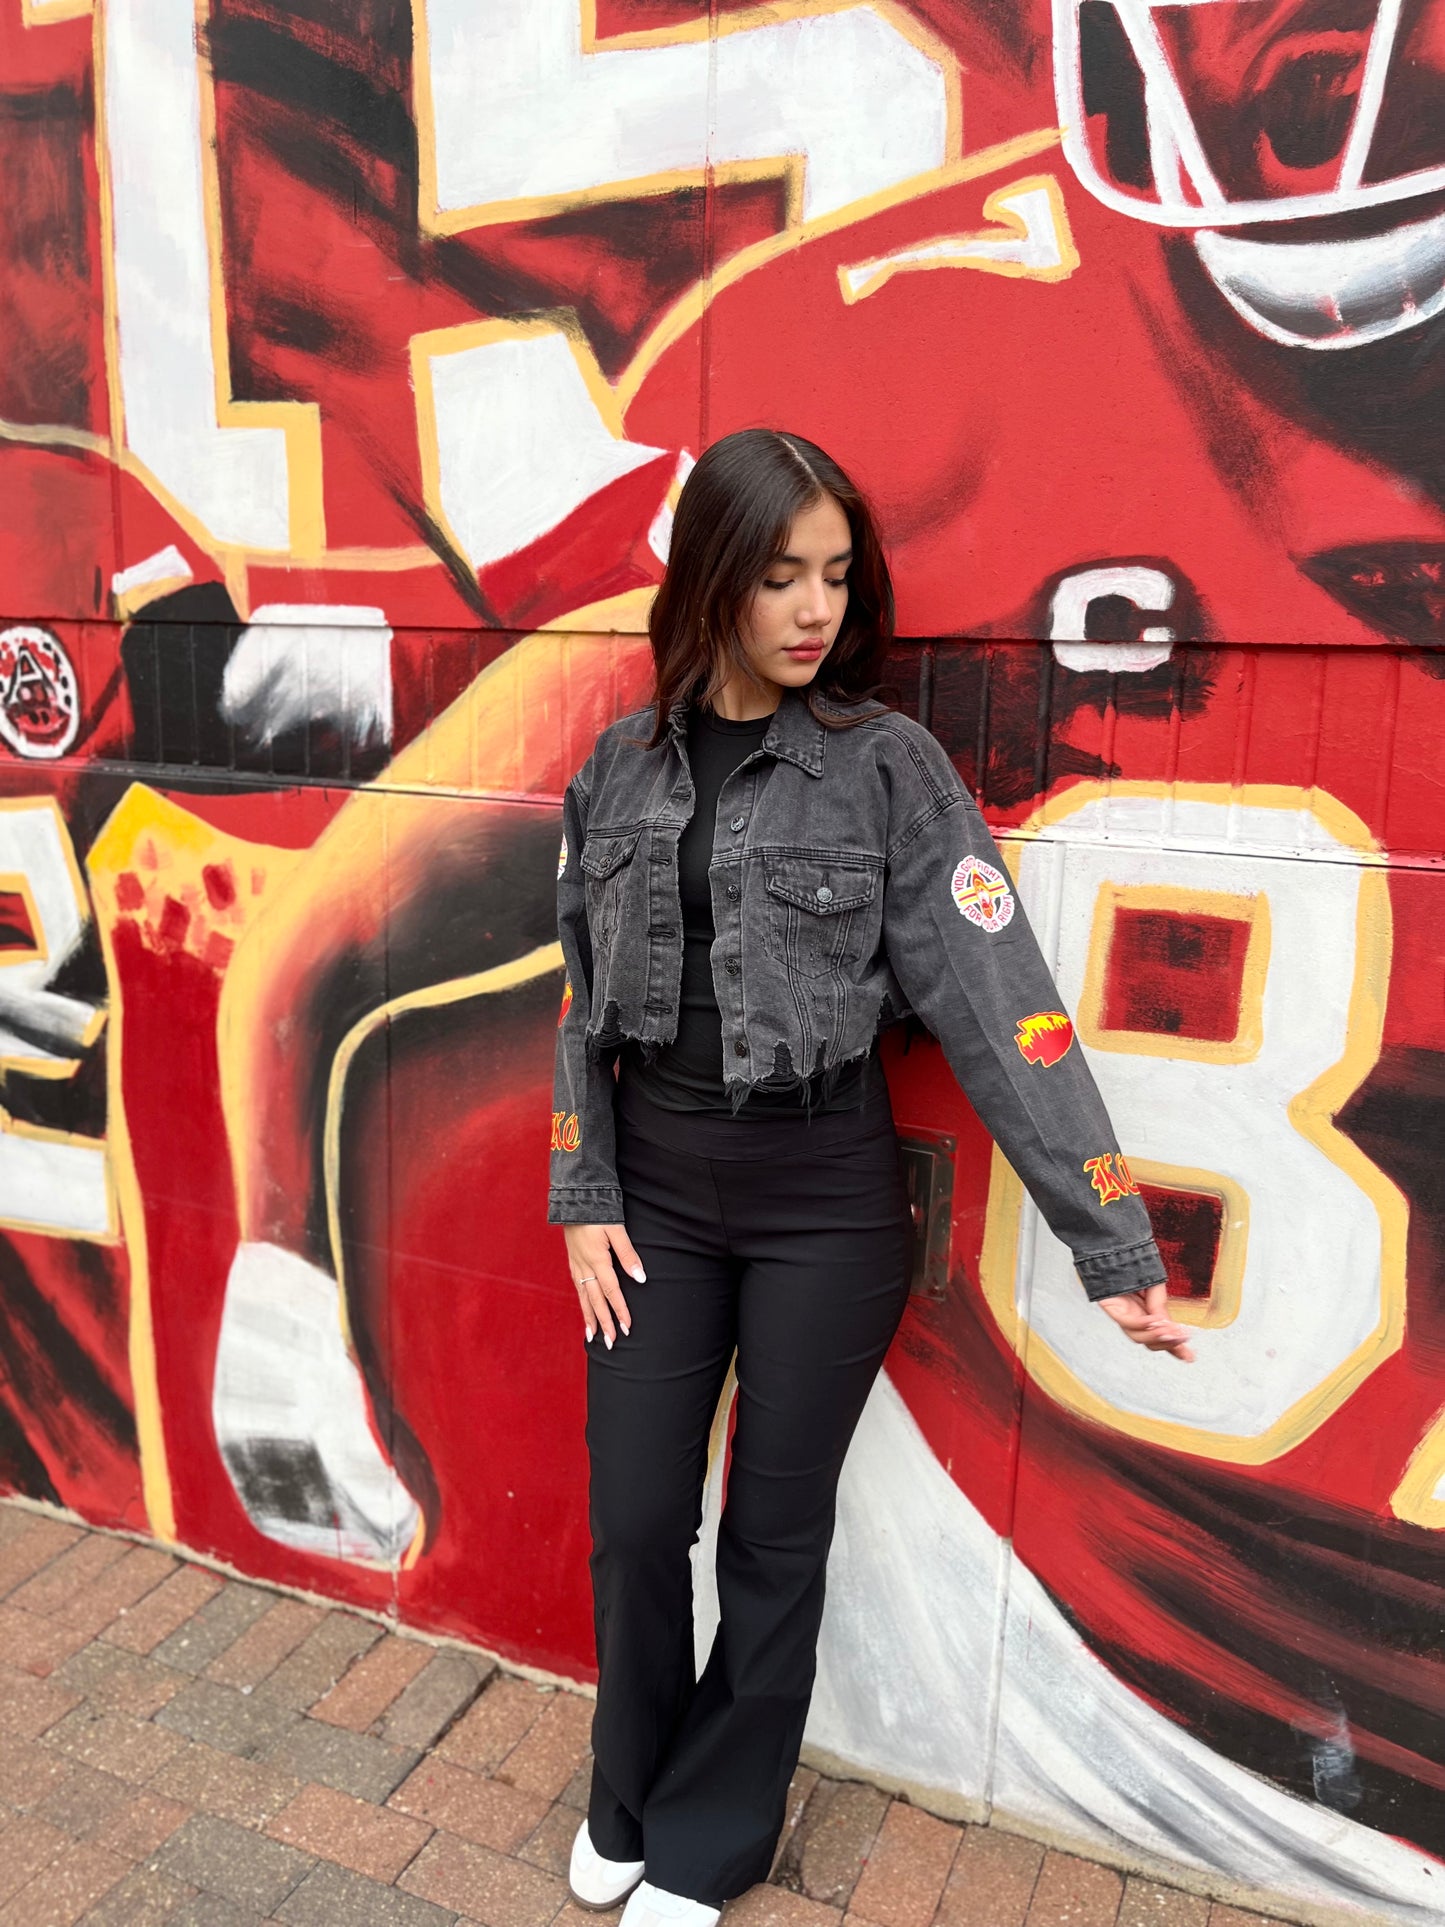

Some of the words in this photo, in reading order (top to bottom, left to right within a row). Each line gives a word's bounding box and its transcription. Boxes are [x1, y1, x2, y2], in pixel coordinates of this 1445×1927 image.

[1049, 565, 1176, 673] C
[954, 871, 967, 893] YOU
[977, 861, 1002, 881] FIGHT
[963, 904, 982, 923] FOR
[997, 895, 1013, 923] RIGHT
